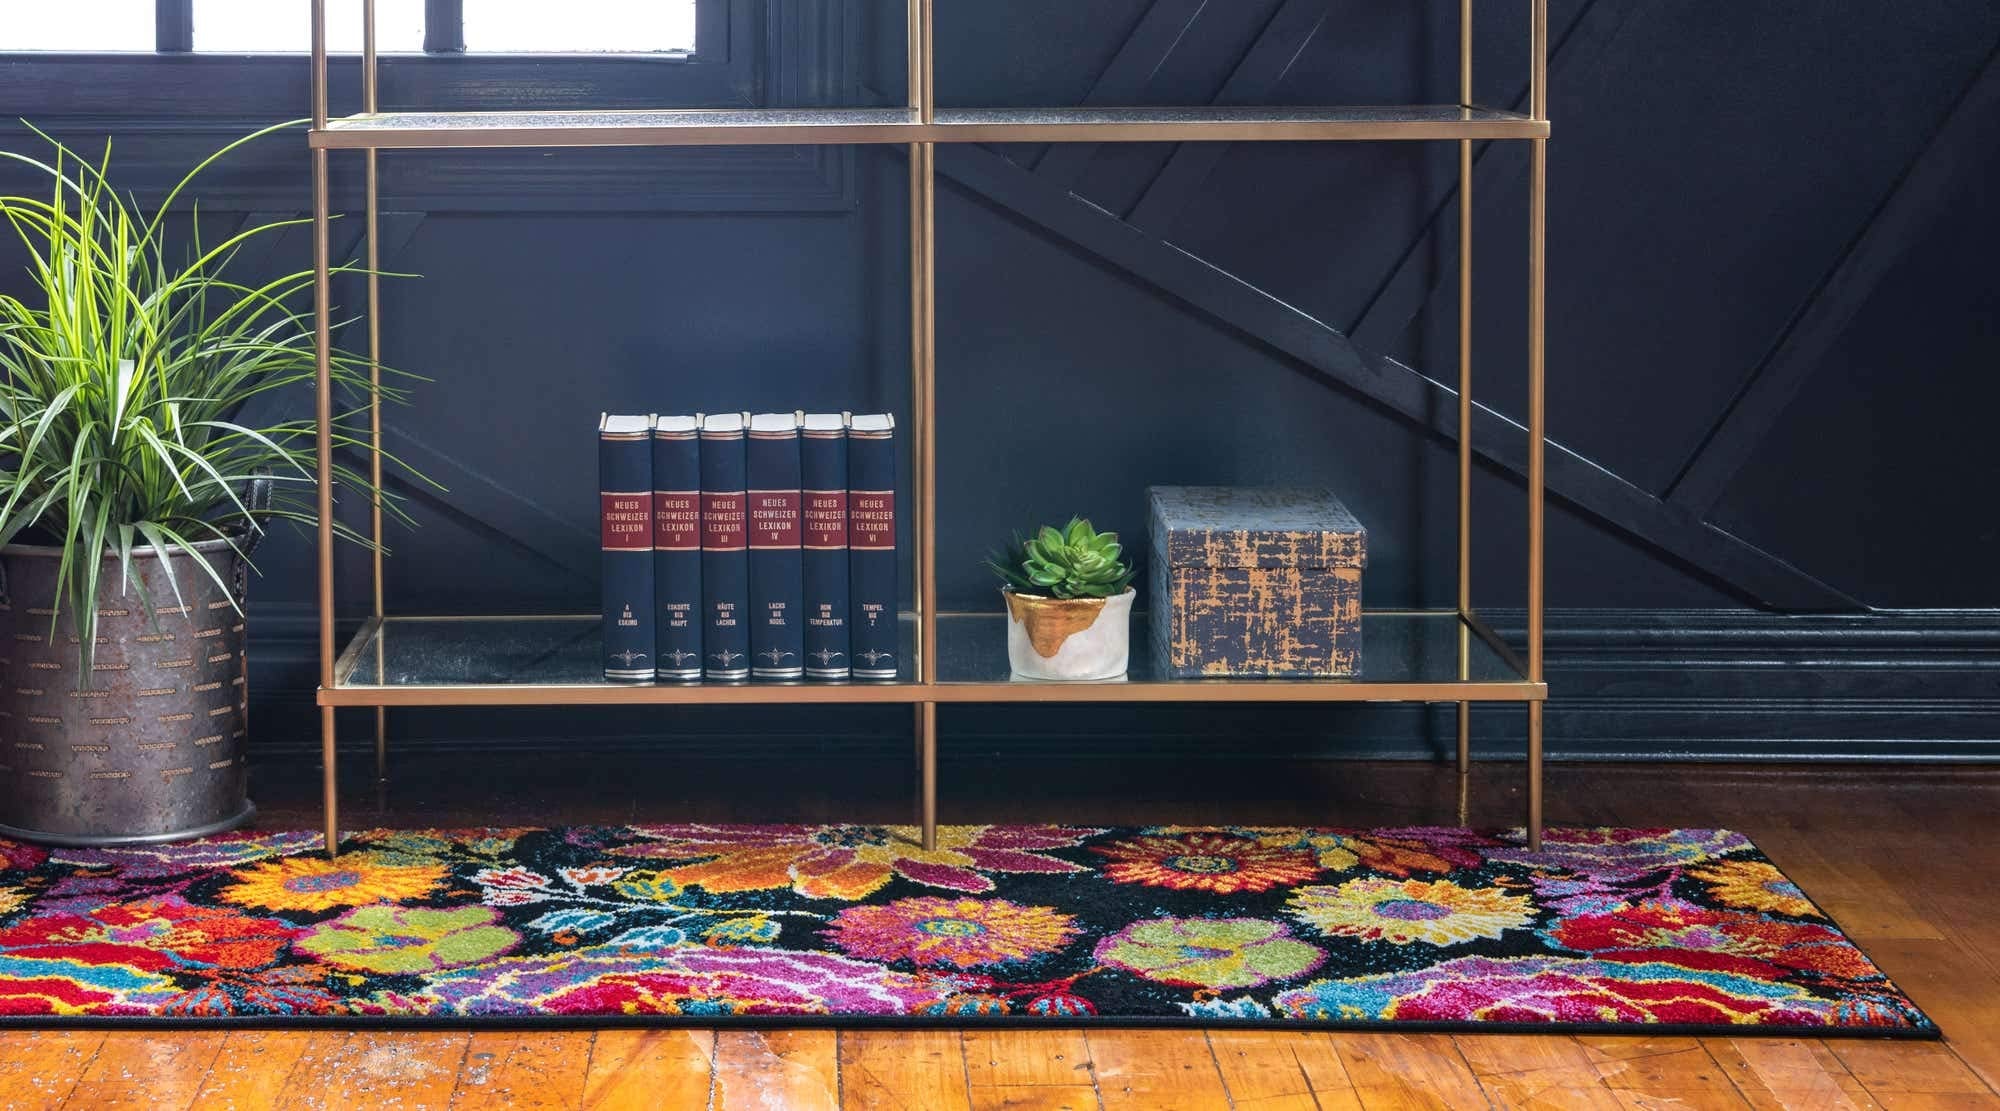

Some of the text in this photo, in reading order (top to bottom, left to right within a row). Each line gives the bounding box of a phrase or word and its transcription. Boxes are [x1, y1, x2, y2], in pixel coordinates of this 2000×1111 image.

[615, 501, 639, 510] NEUES
[665, 500, 690, 508] NEUES
[712, 500, 736, 509] NEUES
[762, 499, 786, 507] NEUES
[813, 499, 837, 507] NEUES
[860, 500, 884, 508] NEUES
[704, 512, 745, 520] SCHWEIZER
[753, 510, 797, 518] SCHWEIZER
[805, 511, 846, 519] SCHWEIZER
[851, 512, 893, 520] SCHWEIZER
[611, 523, 644, 532] LEXIKON
[662, 523, 694, 531] LEXIKON
[709, 523, 740, 532] LEXIKON
[759, 522, 791, 530] LEXIKON
[856, 523, 888, 531] LEXIKON
[675, 534, 680, 542] II
[771, 533, 778, 541] IV
[823, 534, 828, 542] V
[869, 534, 876, 542] VI
